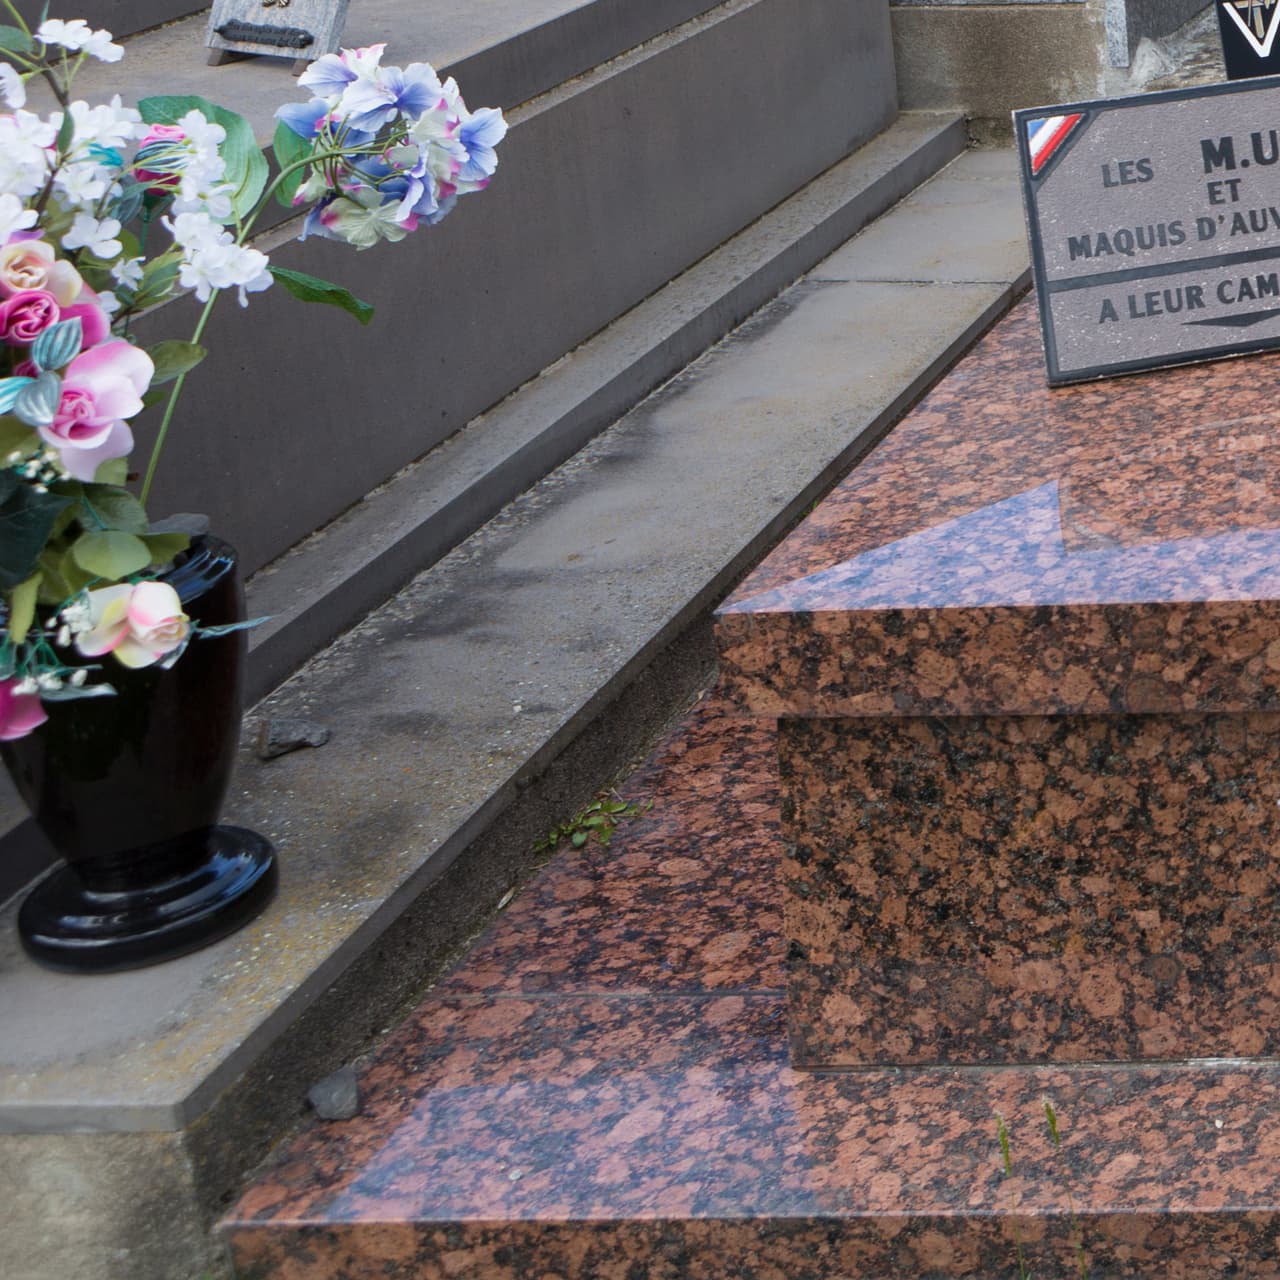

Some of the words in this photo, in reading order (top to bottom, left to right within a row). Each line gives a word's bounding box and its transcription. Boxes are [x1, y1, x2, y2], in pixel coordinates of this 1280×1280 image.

[1102, 158, 1154, 188] LES
[1207, 178, 1242, 205] ET
[1067, 220, 1186, 261] MAQUIS
[1099, 298, 1119, 324] A
[1128, 284, 1206, 320] LEUR
